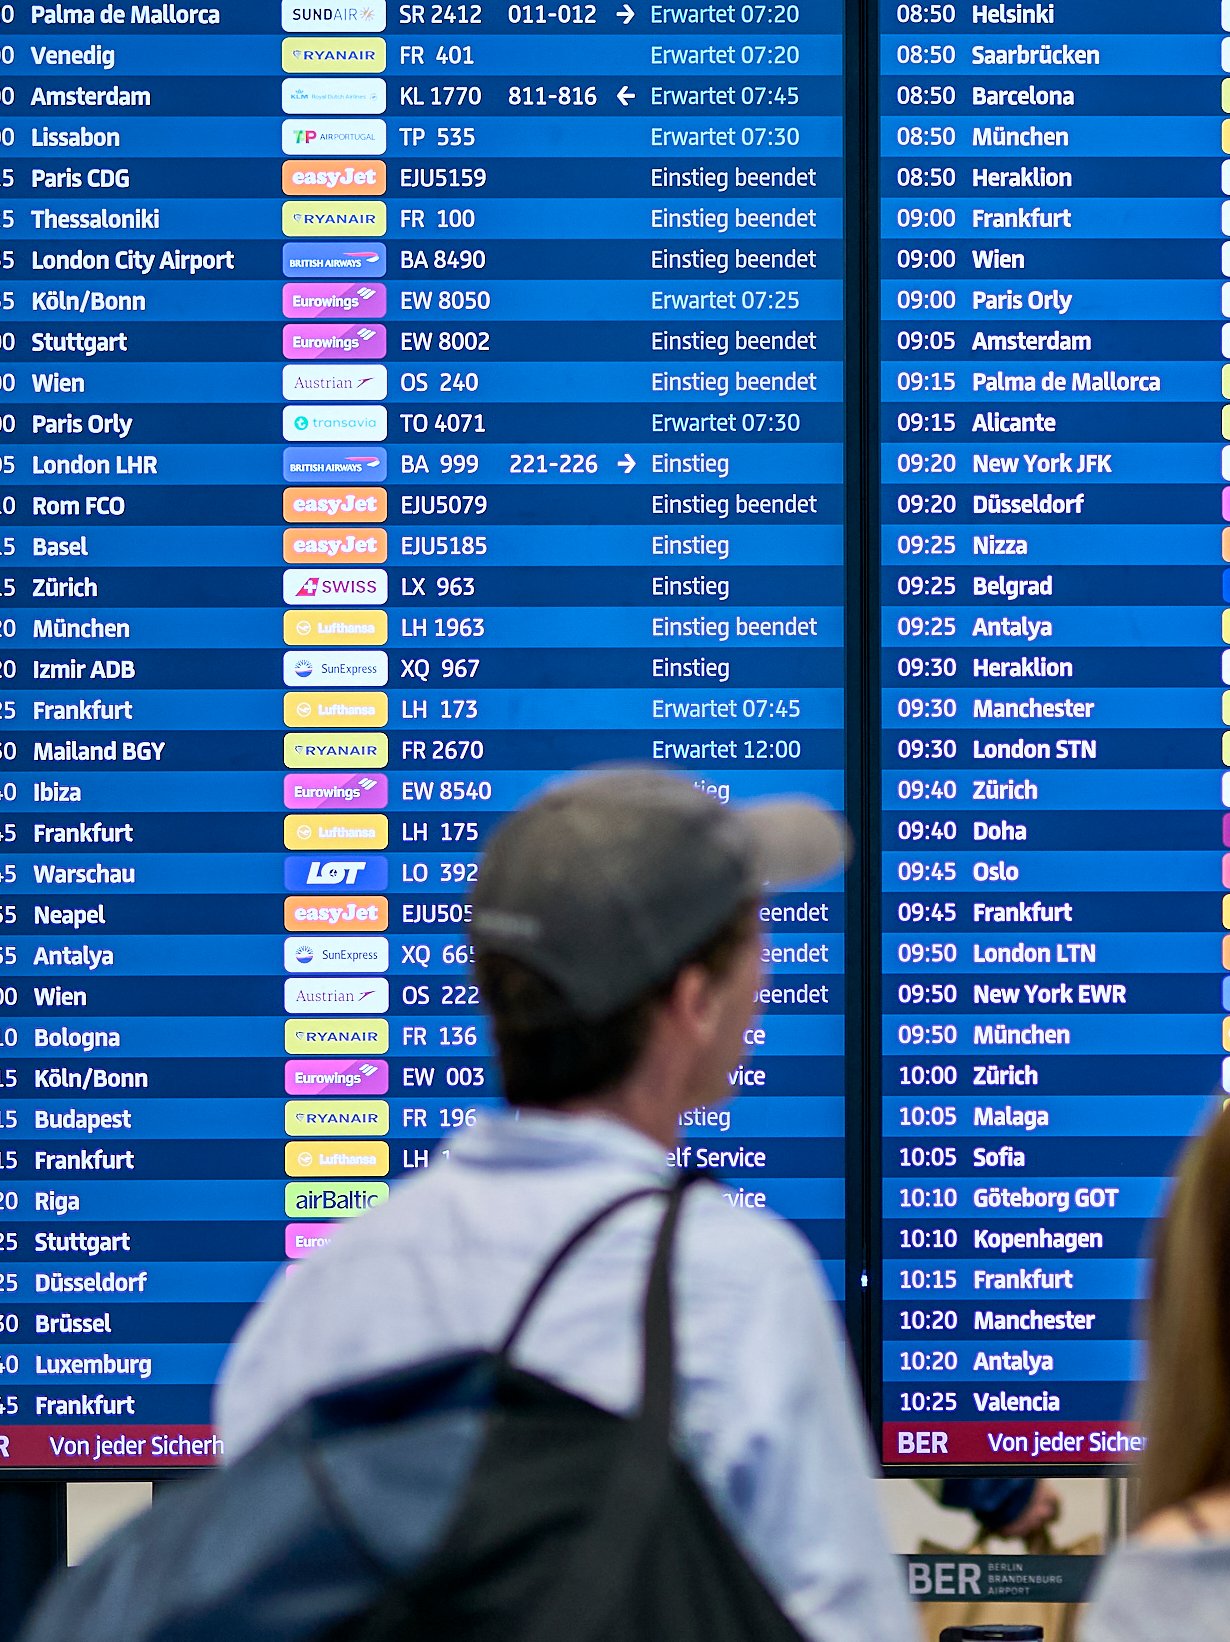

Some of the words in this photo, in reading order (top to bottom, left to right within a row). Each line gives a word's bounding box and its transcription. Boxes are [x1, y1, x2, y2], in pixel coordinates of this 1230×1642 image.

[31, 3, 95, 25] Palma
[100, 3, 126, 24] de
[130, 3, 220, 25] Mallorca
[292, 8, 358, 21] SUNDAIR
[399, 4, 425, 24] SR
[431, 4, 482, 24] 2412
[508, 4, 597, 24] 011-012
[651, 4, 736, 24] Erwartet
[741, 4, 799, 23] 07:20
[896, 4, 956, 23] 08:50
[972, 3, 1055, 24] Helsinki
[30, 85, 151, 106] Amsterdam
[290, 92, 308, 100] KLM
[400, 86, 425, 106] KL
[430, 86, 482, 106] 1770
[508, 86, 597, 106] 811-816
[651, 86, 736, 105] Erwartet
[741, 86, 799, 105] 07:45
[32, 249, 110, 270] London
[115, 249, 156, 275] City
[158, 249, 235, 275] Airport
[289, 259, 323, 268] BRITISH
[325, 259, 362, 268] AIRWAYS
[400, 250, 429, 269] BA
[433, 249, 486, 270] 8490
[651, 248, 729, 274] Einstieg
[735, 248, 817, 269] beendet
[897, 453, 957, 473] 09:20
[973, 454, 1020, 473] New
[1023, 452, 1073, 473] York
[1076, 454, 1113, 474] JFK
[897, 616, 956, 637] 09:25
[971, 615, 1053, 642] Antalya
[33, 740, 117, 761] Mailand
[122, 741, 166, 761] BGY
[305, 745, 377, 756] RYANAIR
[402, 740, 426, 760] FR
[432, 740, 484, 760] 2670
[653, 740, 738, 759] Erwartet
[743, 740, 801, 759] 12:00
[898, 820, 957, 841] 09:40
[973, 819, 1027, 841] Doha
[898, 984, 957, 1004] 09:50
[973, 984, 1021, 1004] New
[1023, 982, 1074, 1004] York
[1078, 984, 1127, 1004] EWR
[34, 1026, 121, 1052] Bologna
[306, 1031, 378, 1042] RYANAIR
[403, 1026, 427, 1046] FR
[439, 1026, 477, 1046] 136
[35, 1190, 80, 1216] Riga
[899, 1187, 958, 1208] 10:10
[973, 1186, 1068, 1213] Göteborg
[1073, 1188, 1119, 1208] GOT
[34, 1354, 152, 1380] Luxemburg
[900, 1391, 957, 1411] 10:25
[973, 1391, 1061, 1412] Valencia
[49, 1436, 90, 1455] Von
[93, 1434, 146, 1460] jeder
[898, 1431, 948, 1454] BER
[988, 1432, 1028, 1452] Von
[1031, 1431, 1084, 1457] jeder
[908, 1562, 982, 1595] BER
[987, 1563, 1023, 1572] BERLIN
[987, 1575, 1063, 1584] BRANDENBURG
[987, 1587, 1030, 1596] AIRPORT
